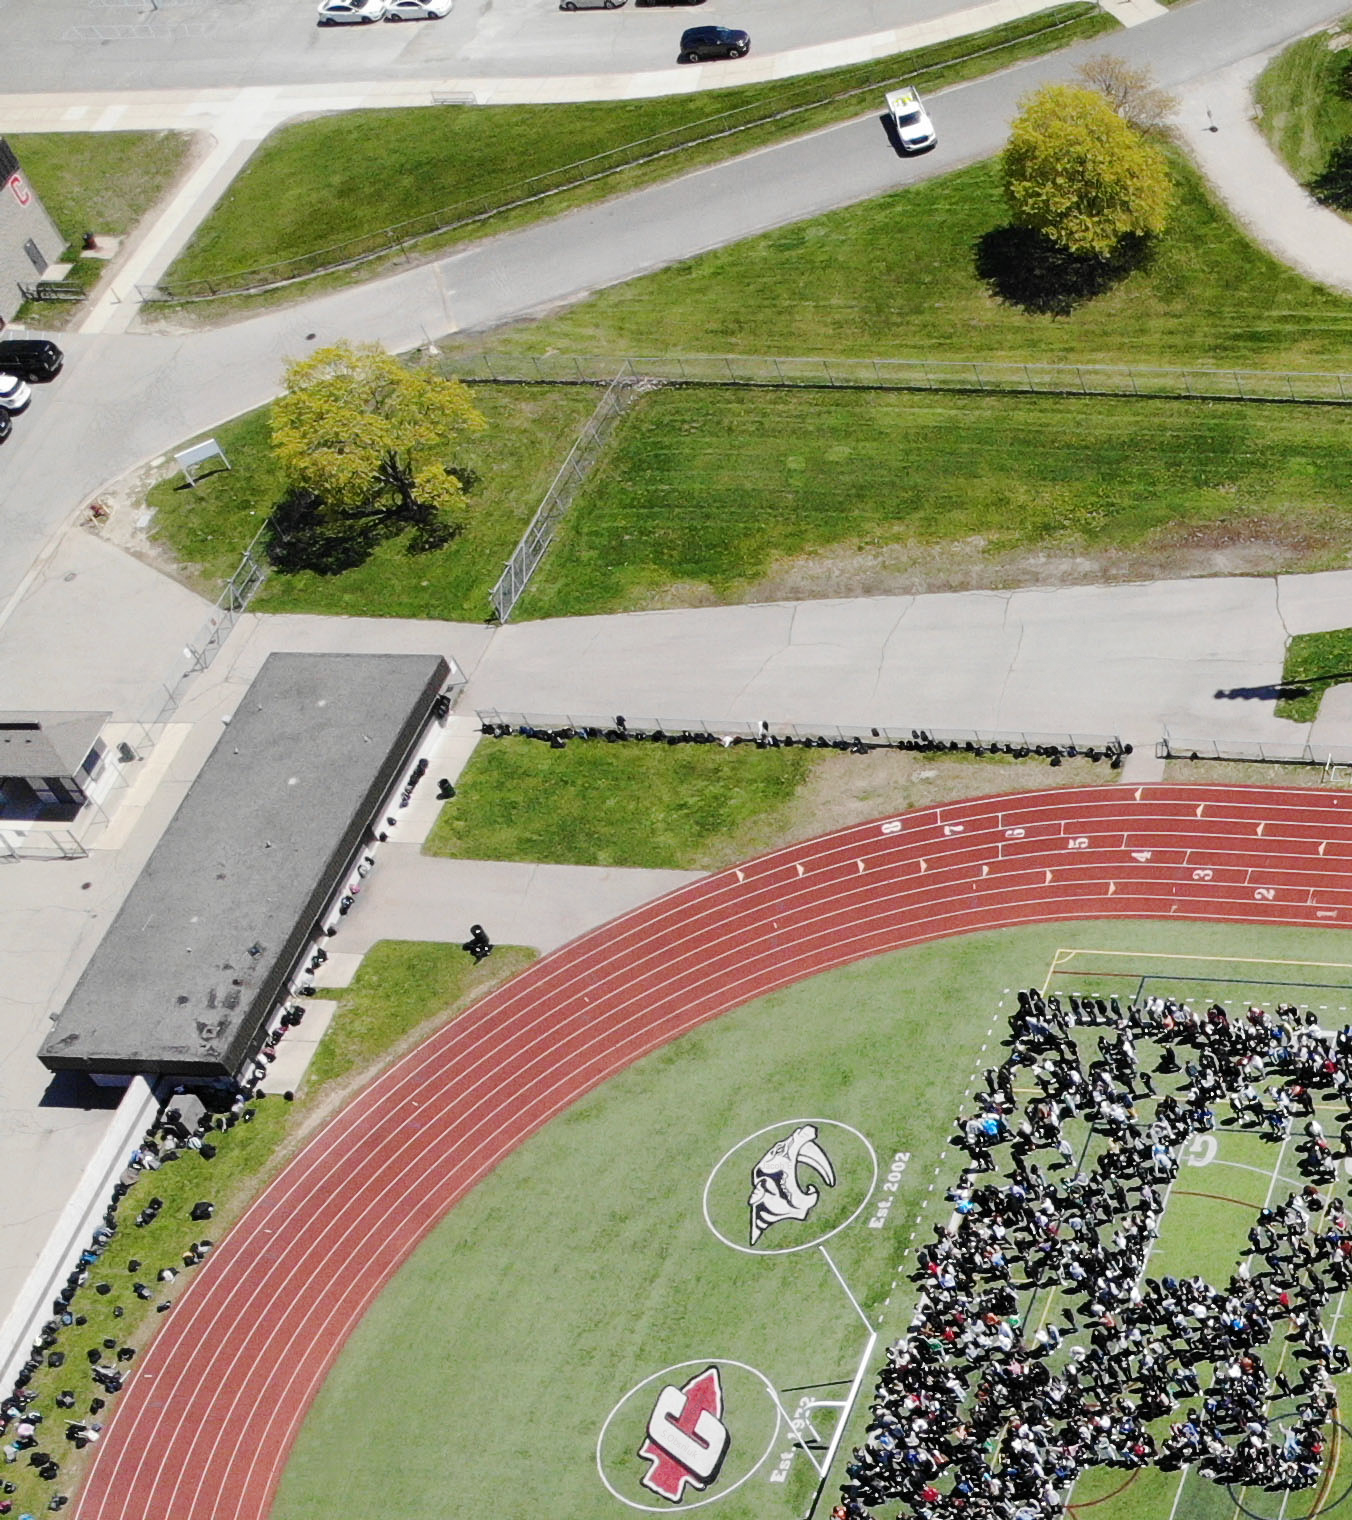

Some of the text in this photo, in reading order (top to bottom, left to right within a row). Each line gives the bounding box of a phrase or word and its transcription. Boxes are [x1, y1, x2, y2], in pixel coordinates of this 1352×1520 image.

[9, 174, 33, 209] C
[881, 820, 902, 834] 8
[943, 825, 965, 836] 7
[1005, 828, 1026, 838] 6
[1067, 837, 1089, 849] 5
[1130, 851, 1152, 863] 4
[1192, 869, 1214, 881] 3
[1254, 888, 1276, 900] 2
[1316, 910, 1338, 918] 1
[868, 1152, 911, 1229] Est. 2002
[770, 1447, 796, 1482] Est.
